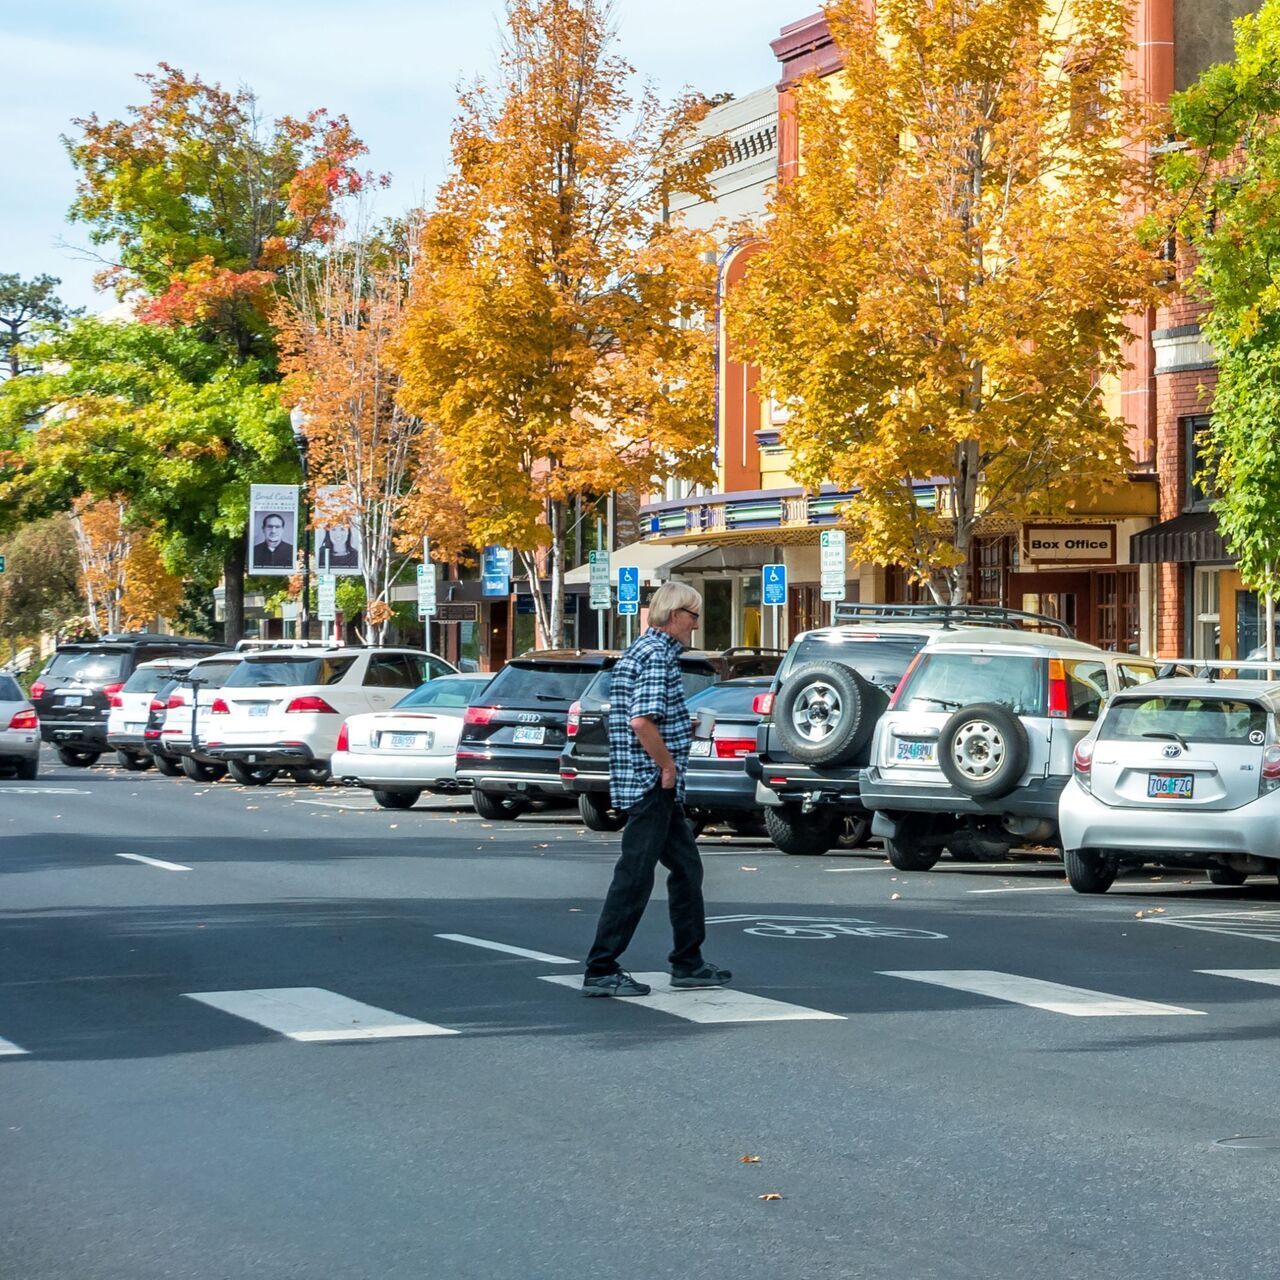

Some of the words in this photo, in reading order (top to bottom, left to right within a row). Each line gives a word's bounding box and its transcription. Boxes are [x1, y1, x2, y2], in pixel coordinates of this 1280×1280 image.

[1032, 539, 1059, 549] Box
[1064, 539, 1108, 549] Office
[1151, 778, 1168, 792] 706
[1173, 778, 1191, 792] FZC
